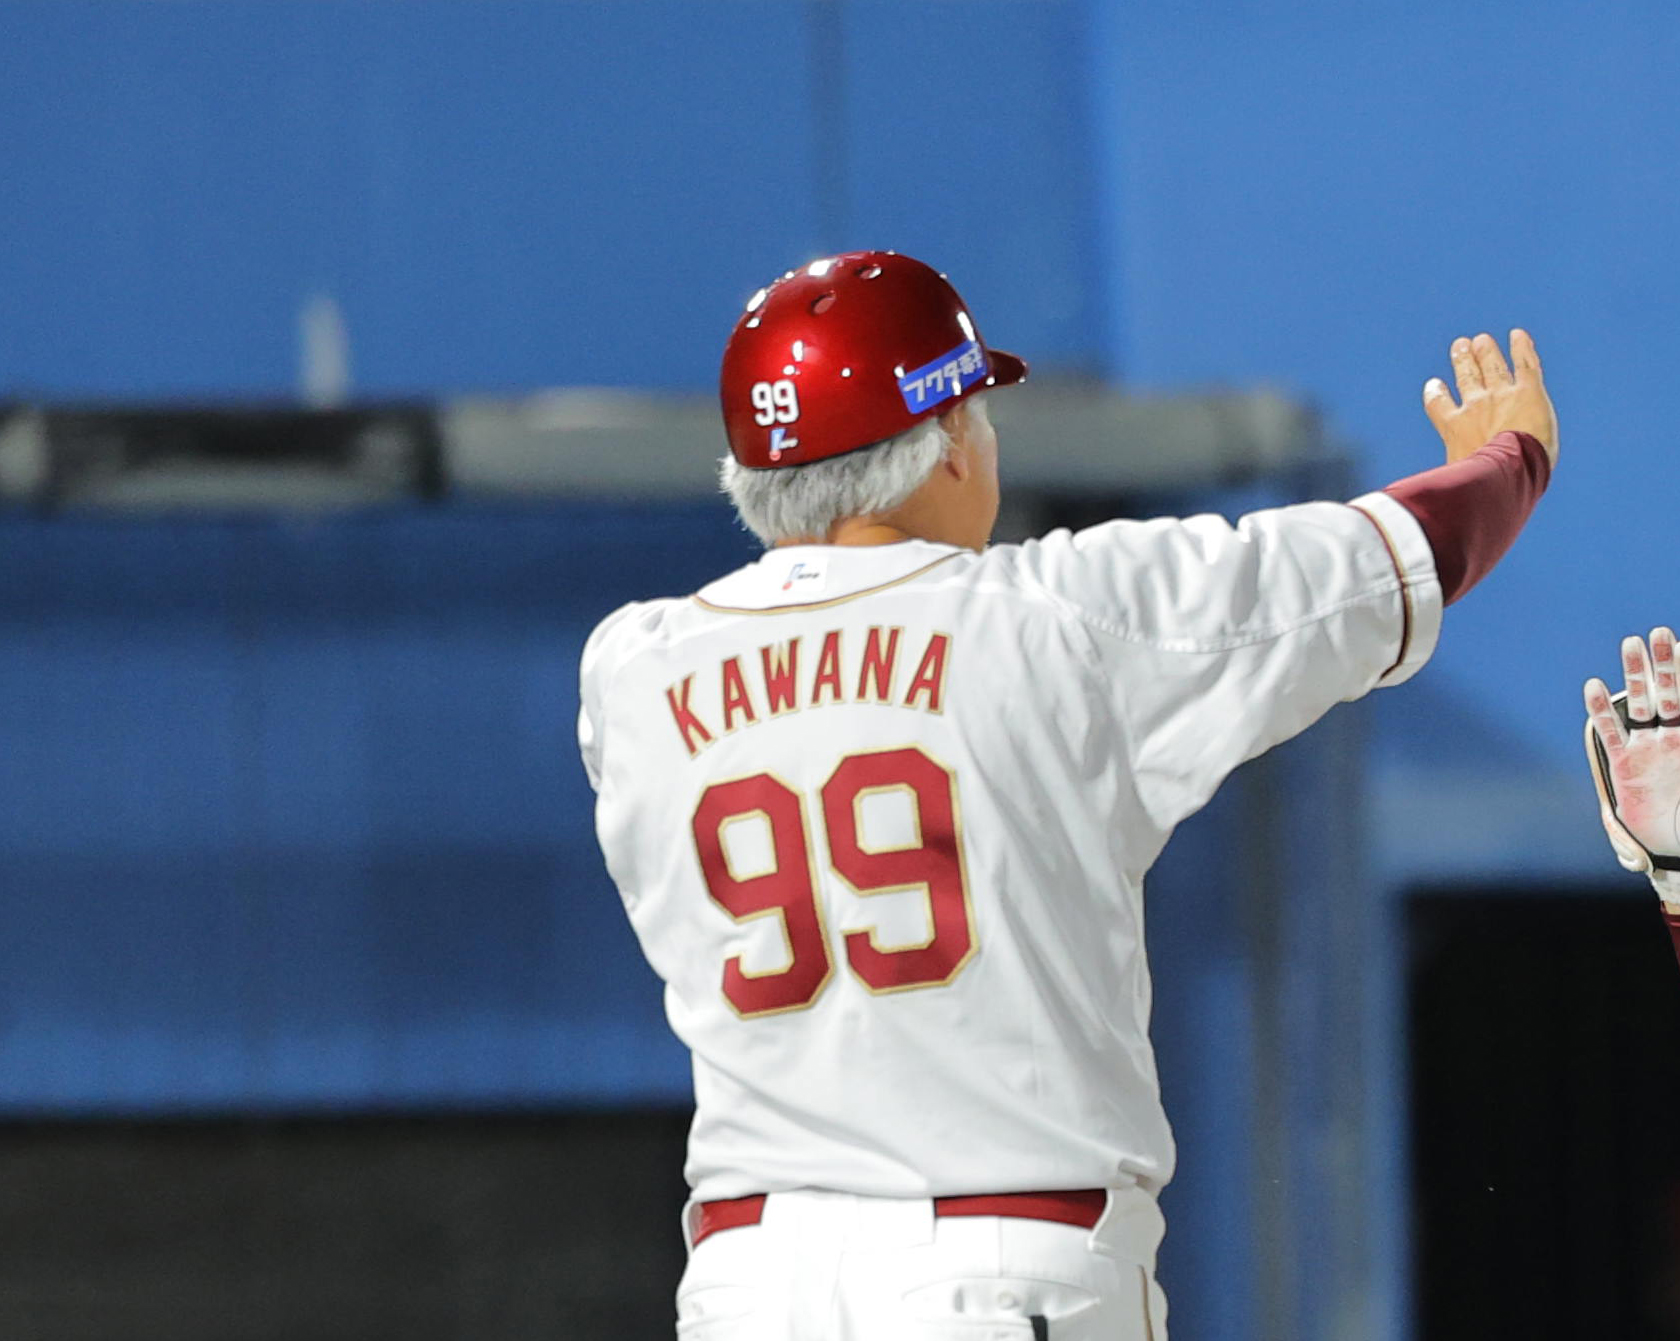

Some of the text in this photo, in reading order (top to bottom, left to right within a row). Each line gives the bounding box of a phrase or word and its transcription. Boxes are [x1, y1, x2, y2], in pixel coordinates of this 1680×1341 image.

[751, 379, 800, 426] 99
[665, 626, 952, 759] KAWANA
[690, 743, 979, 1020] 99
